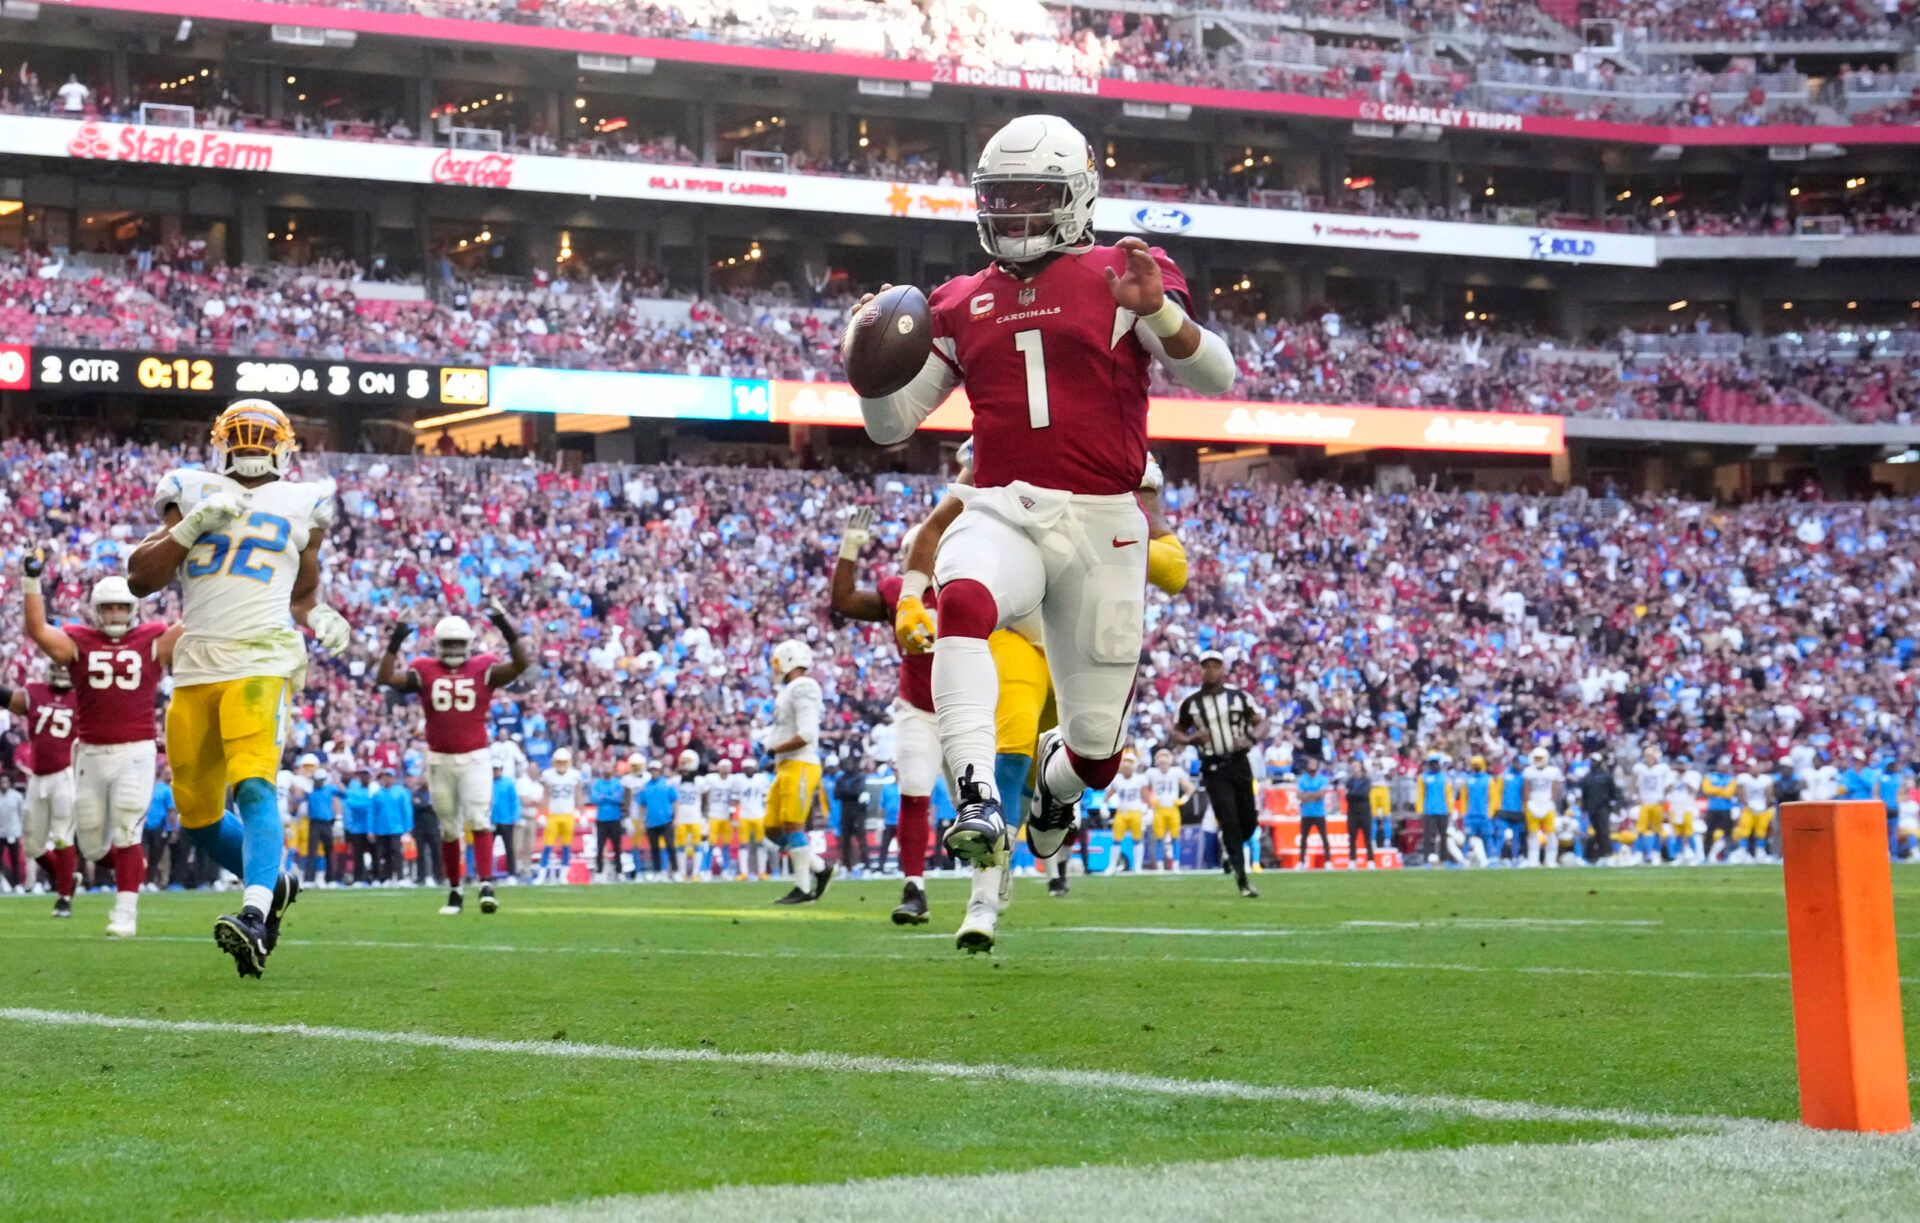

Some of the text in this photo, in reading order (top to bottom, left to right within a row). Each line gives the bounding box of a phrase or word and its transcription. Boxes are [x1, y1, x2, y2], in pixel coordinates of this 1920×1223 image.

[932, 64, 1099, 95] 22 ROGER WEHRLI
[1359, 101, 1523, 131] 62 CHARLEY TRIPPI
[995, 306, 1062, 324] CARDINALS
[41, 355, 63, 383] 2
[69, 358, 119, 383] QTR
[138, 357, 214, 390] 0:12
[359, 371, 395, 394] ON
[1014, 329, 1050, 430] 1
[88, 649, 142, 690] 53
[432, 678, 476, 712] 65
[34, 704, 74, 739] 75
